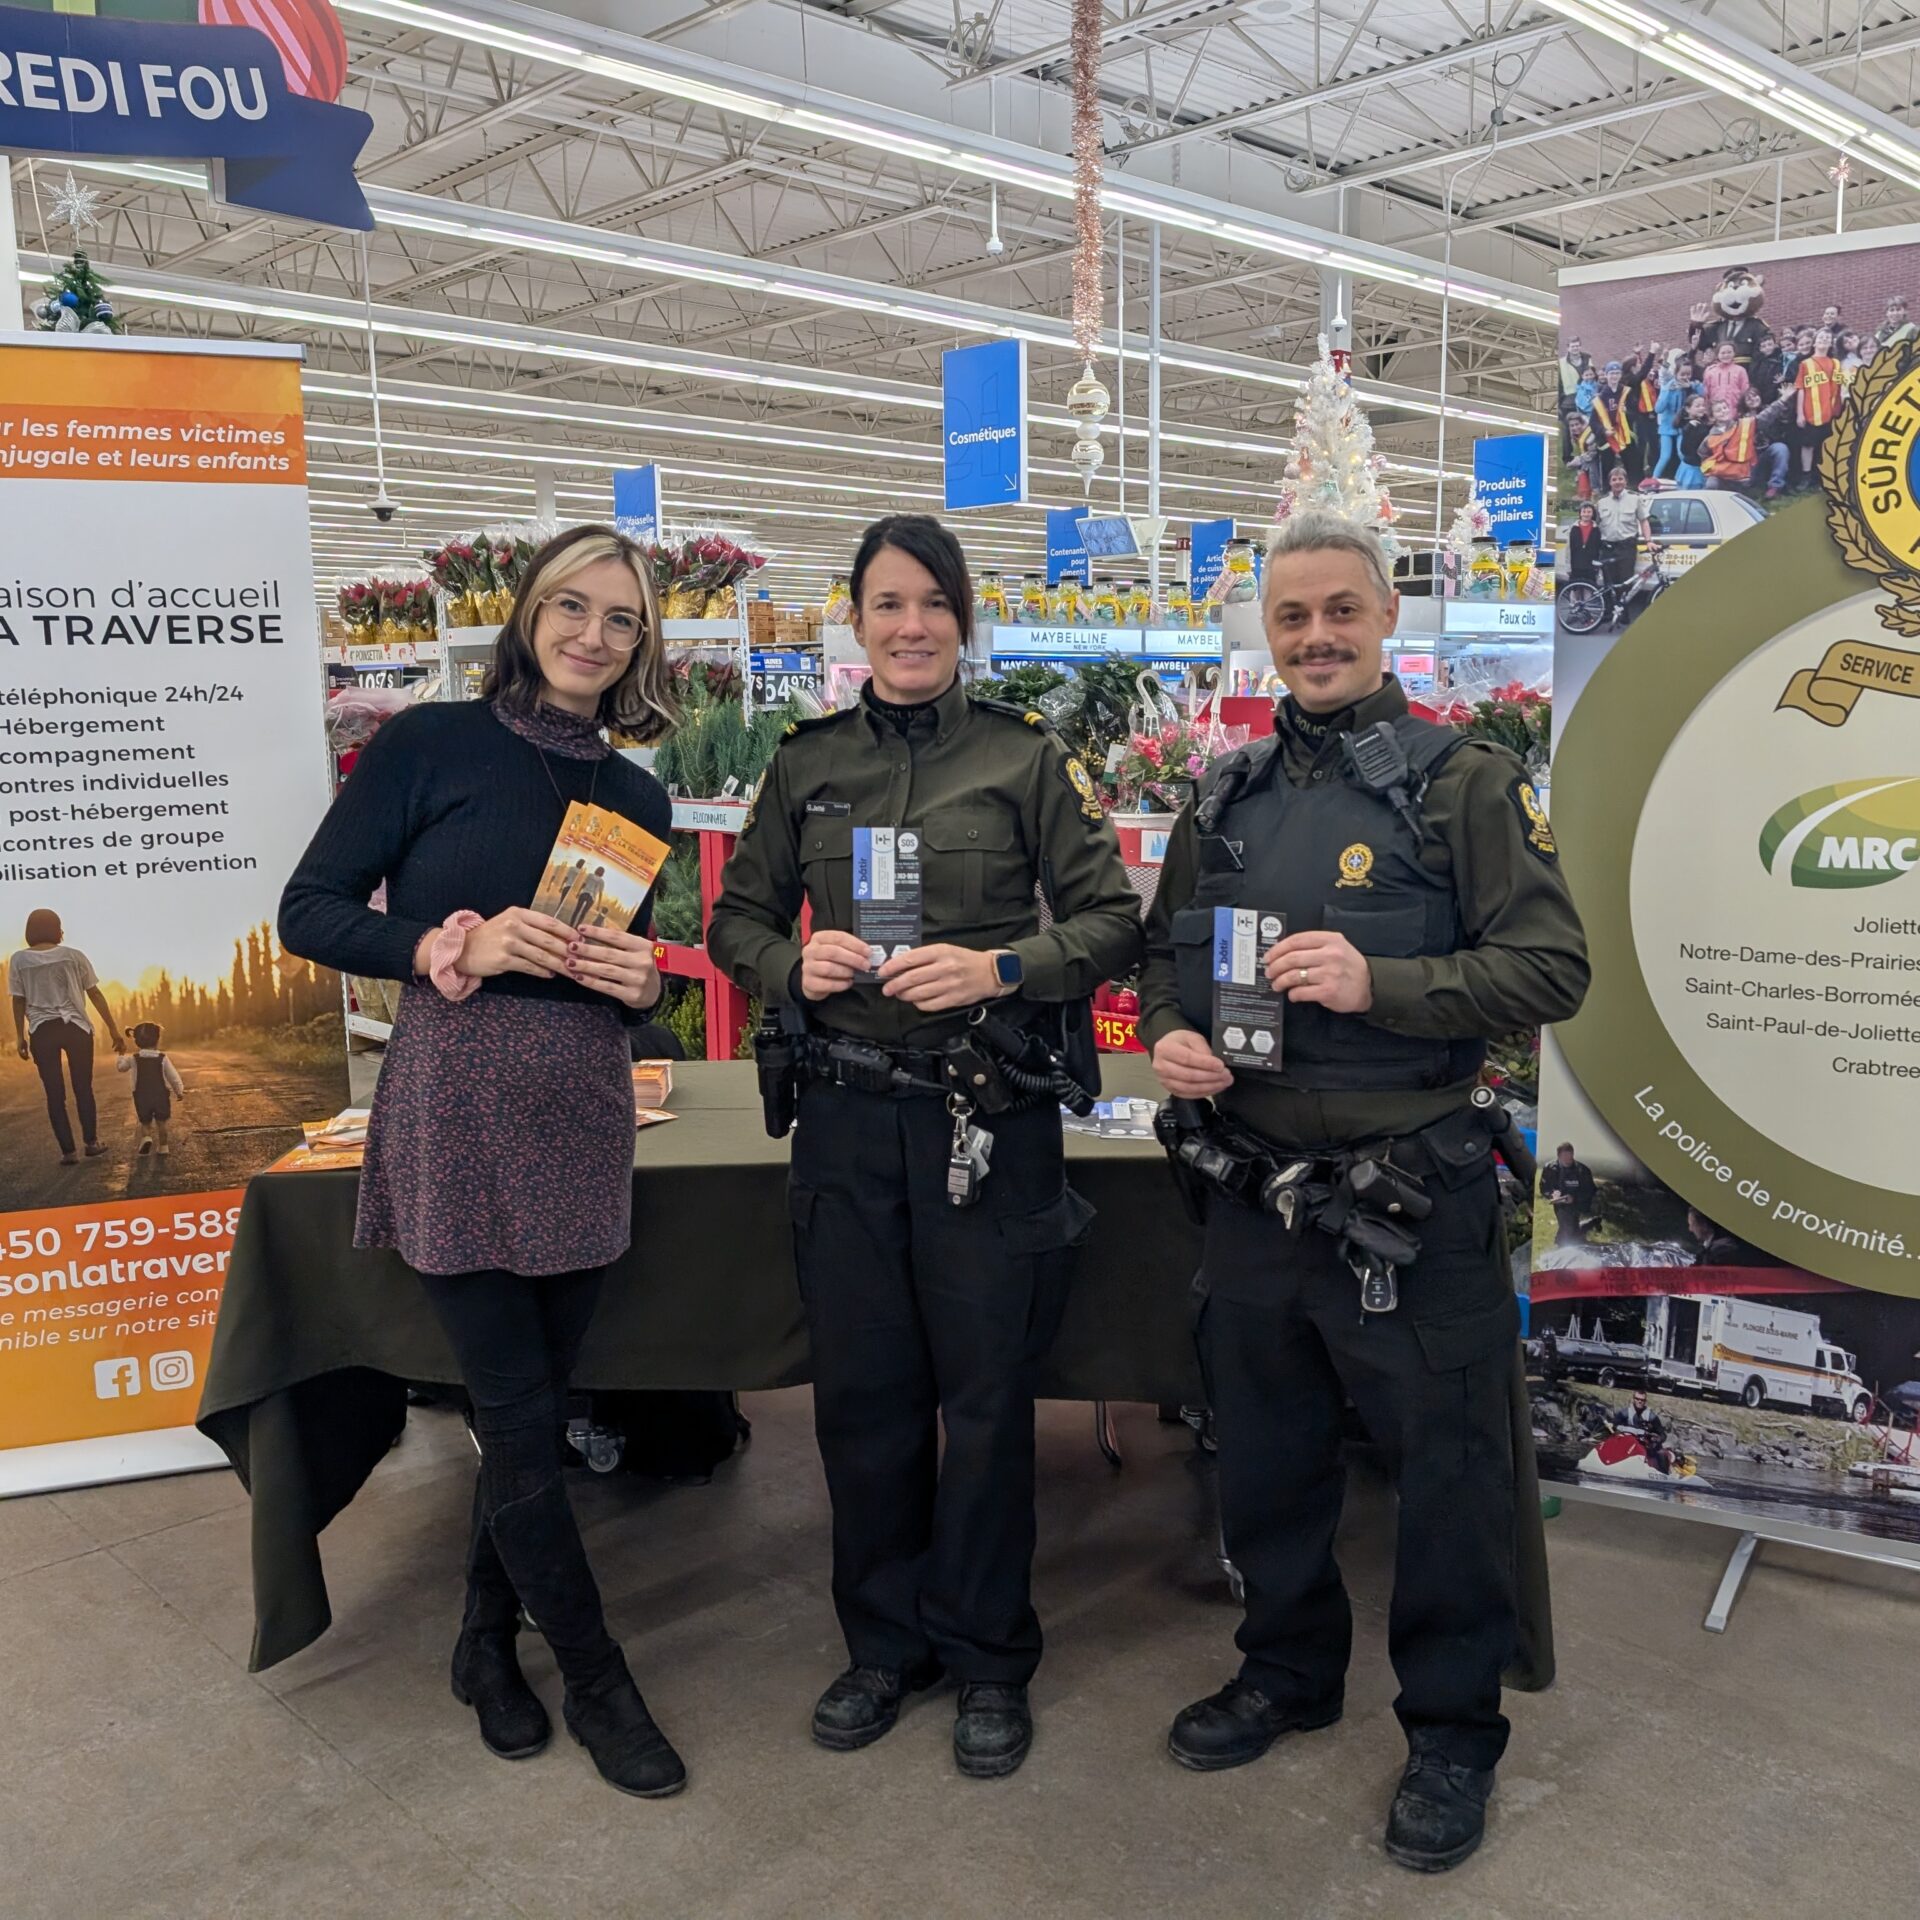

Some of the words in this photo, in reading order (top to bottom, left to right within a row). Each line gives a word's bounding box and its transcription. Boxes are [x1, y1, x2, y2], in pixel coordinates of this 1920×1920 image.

[139, 63, 268, 120] FOU
[22, 417, 58, 437] les
[67, 419, 172, 441] femmes
[180, 424, 285, 444] victimes
[949, 425, 1017, 446] Cosmétiques
[97, 449, 122, 466] et
[130, 449, 190, 468] leurs
[197, 451, 290, 470] enfants
[1479, 476, 1526, 492] Produits
[1494, 493, 1523, 507] soins
[1070, 558, 1086, 567] pour
[111, 579, 280, 609] d'accueil
[1499, 609, 1520, 625] Faux
[1522, 610, 1536, 626] cils
[32, 614, 284, 646] TRAVERSE
[1030, 632, 1108, 644] MAYBELLINE
[1177, 634, 1220, 645] MAYBEL
[1840, 652, 1914, 684] SERVICE
[164, 684, 244, 704] 24h/24
[1295, 715, 1327, 737] POLIC
[82, 771, 229, 792] individuelles
[9, 799, 229, 826] post-hébergement
[0, 831, 94, 852] contres
[103, 831, 132, 847] de
[140, 830, 225, 850] groupe
[901, 838, 916, 847] SOS
[1818, 836, 1920, 871] MRC
[0, 861, 97, 881] ilisation
[104, 860, 128, 876] et
[136, 854, 257, 878] prévention
[1264, 922, 1279, 932] SOS
[1854, 916, 1920, 935] Joliett
[1706, 1012, 1920, 1043] Saint-Paul-de-Joliette
[1832, 1056, 1920, 1079] Crabtree
[1634, 1085, 1665, 1121] La
[1658, 1120, 1733, 1183] police
[1736, 1179, 1770, 1206] de
[24, 1291, 168, 1323] messagerie
[69, 1325, 107, 1342] sur
[116, 1315, 180, 1337] notre
